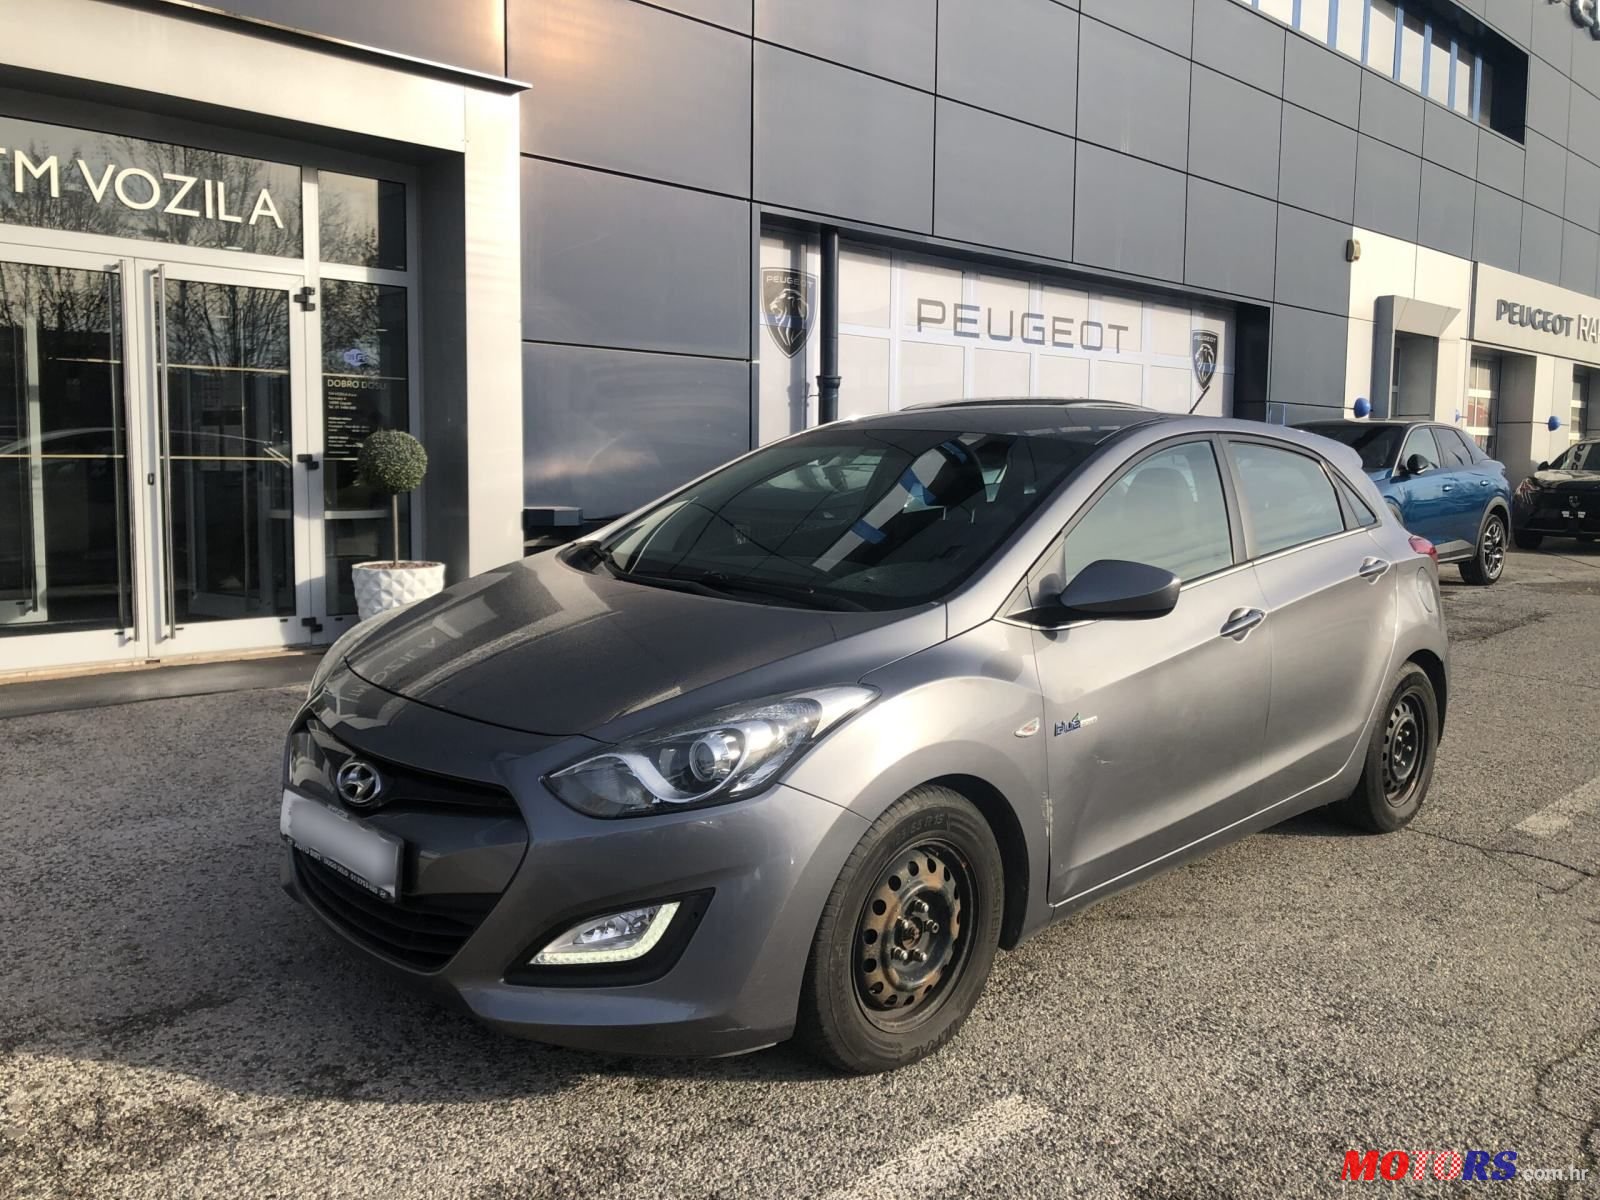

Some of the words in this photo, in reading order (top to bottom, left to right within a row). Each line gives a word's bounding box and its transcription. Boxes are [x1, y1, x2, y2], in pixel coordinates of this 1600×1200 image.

[77, 159, 284, 229] VOZILA
[766, 275, 814, 288] PEUGEOT
[917, 297, 1129, 354] PEUGEOT
[1496, 298, 1574, 337] PEUGEOT
[327, 379, 359, 388] DOBRO
